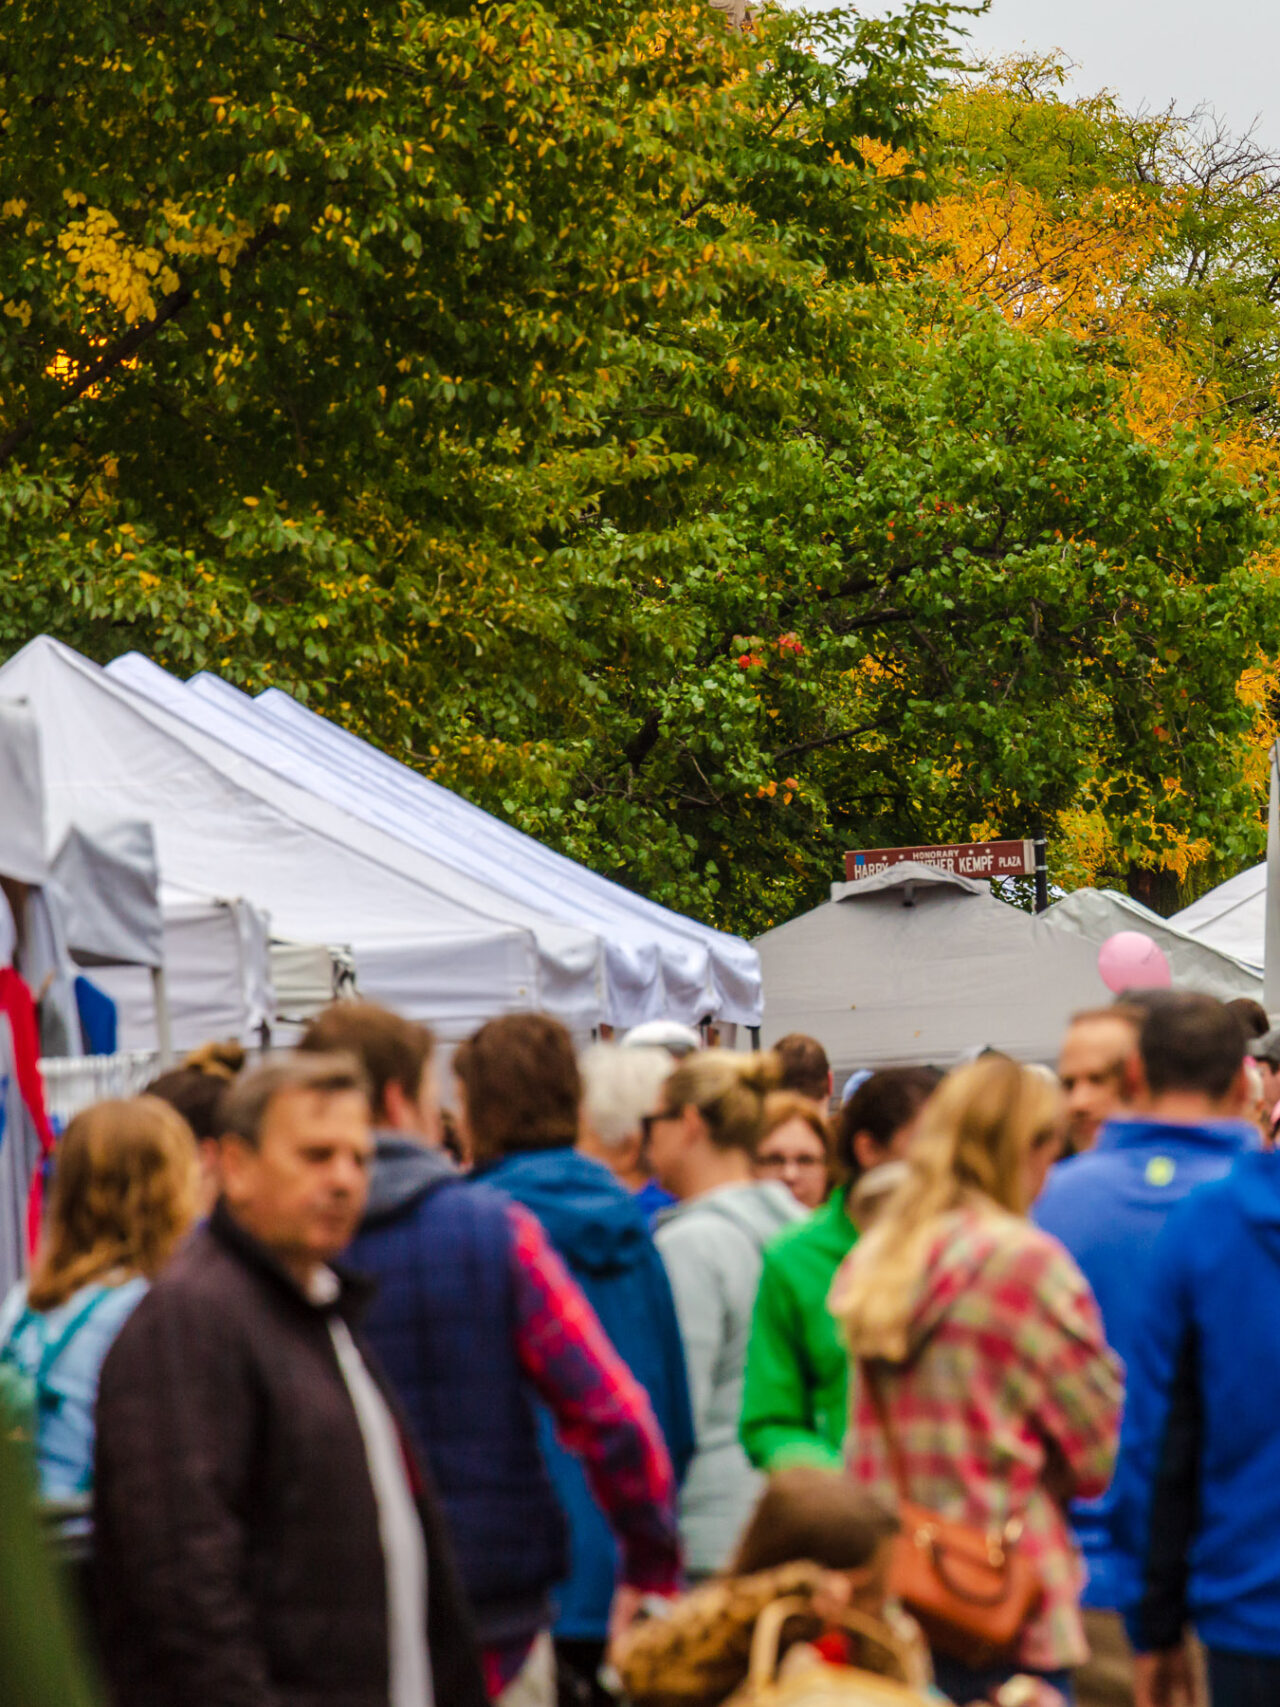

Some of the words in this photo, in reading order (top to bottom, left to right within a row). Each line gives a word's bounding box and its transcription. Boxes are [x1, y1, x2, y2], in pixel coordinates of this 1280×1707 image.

[912, 849, 959, 860] HONORARY
[959, 855, 994, 873] KEMPF
[998, 856, 1021, 868] PLAZA
